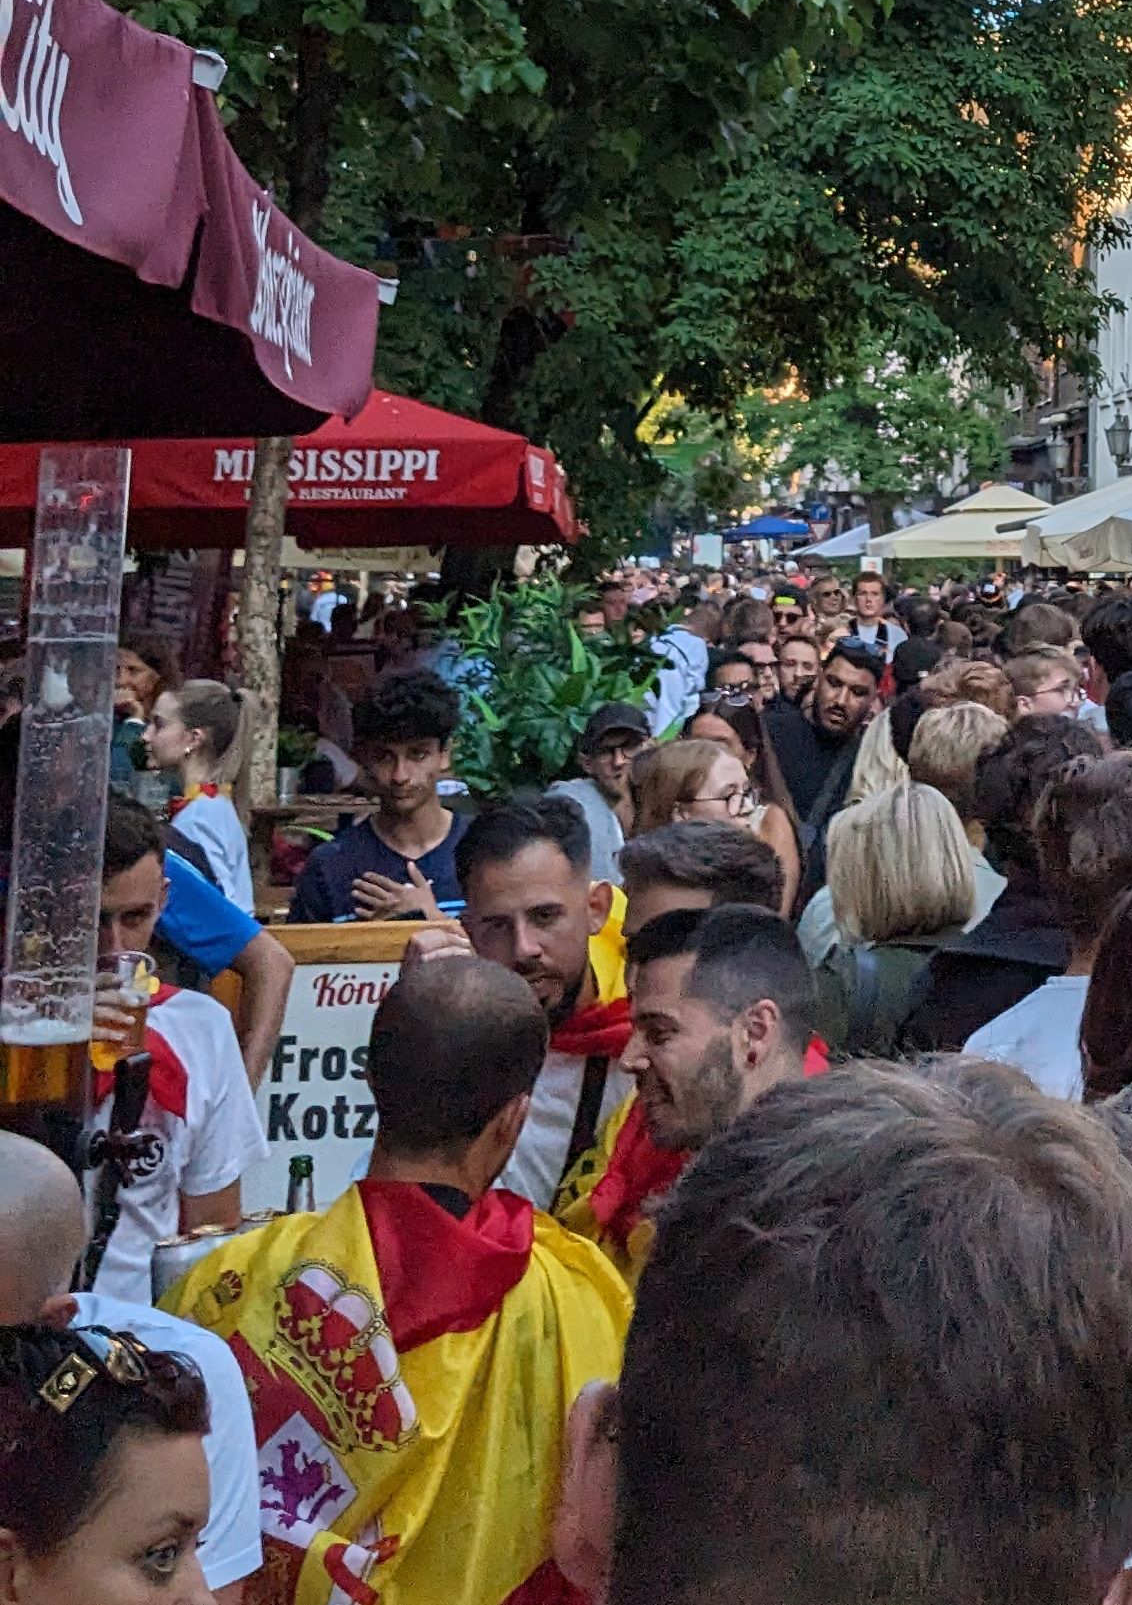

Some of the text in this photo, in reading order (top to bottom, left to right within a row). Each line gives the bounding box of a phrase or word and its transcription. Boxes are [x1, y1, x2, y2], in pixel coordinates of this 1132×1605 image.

[213, 449, 441, 481] MISISSIPPI
[299, 488, 408, 500] RESTAURANT
[313, 972, 389, 1007] Köni
[271, 1035, 370, 1083] Fros
[267, 1093, 376, 1142] Kotz
